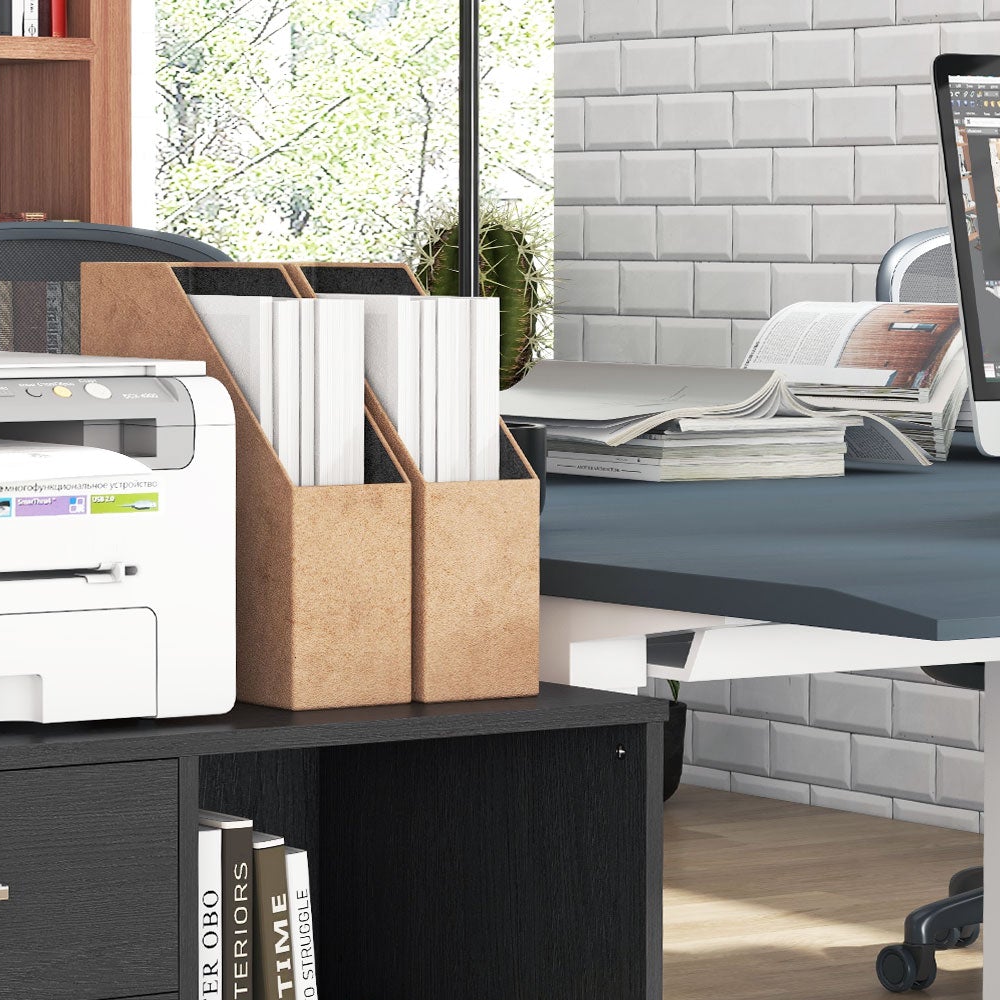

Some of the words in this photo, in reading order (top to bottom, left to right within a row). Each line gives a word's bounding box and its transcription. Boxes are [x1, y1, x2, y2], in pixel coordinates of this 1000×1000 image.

[202, 889, 219, 949] OBO
[271, 893, 294, 999] TIME
[296, 888, 314, 982] STRUGGLE
